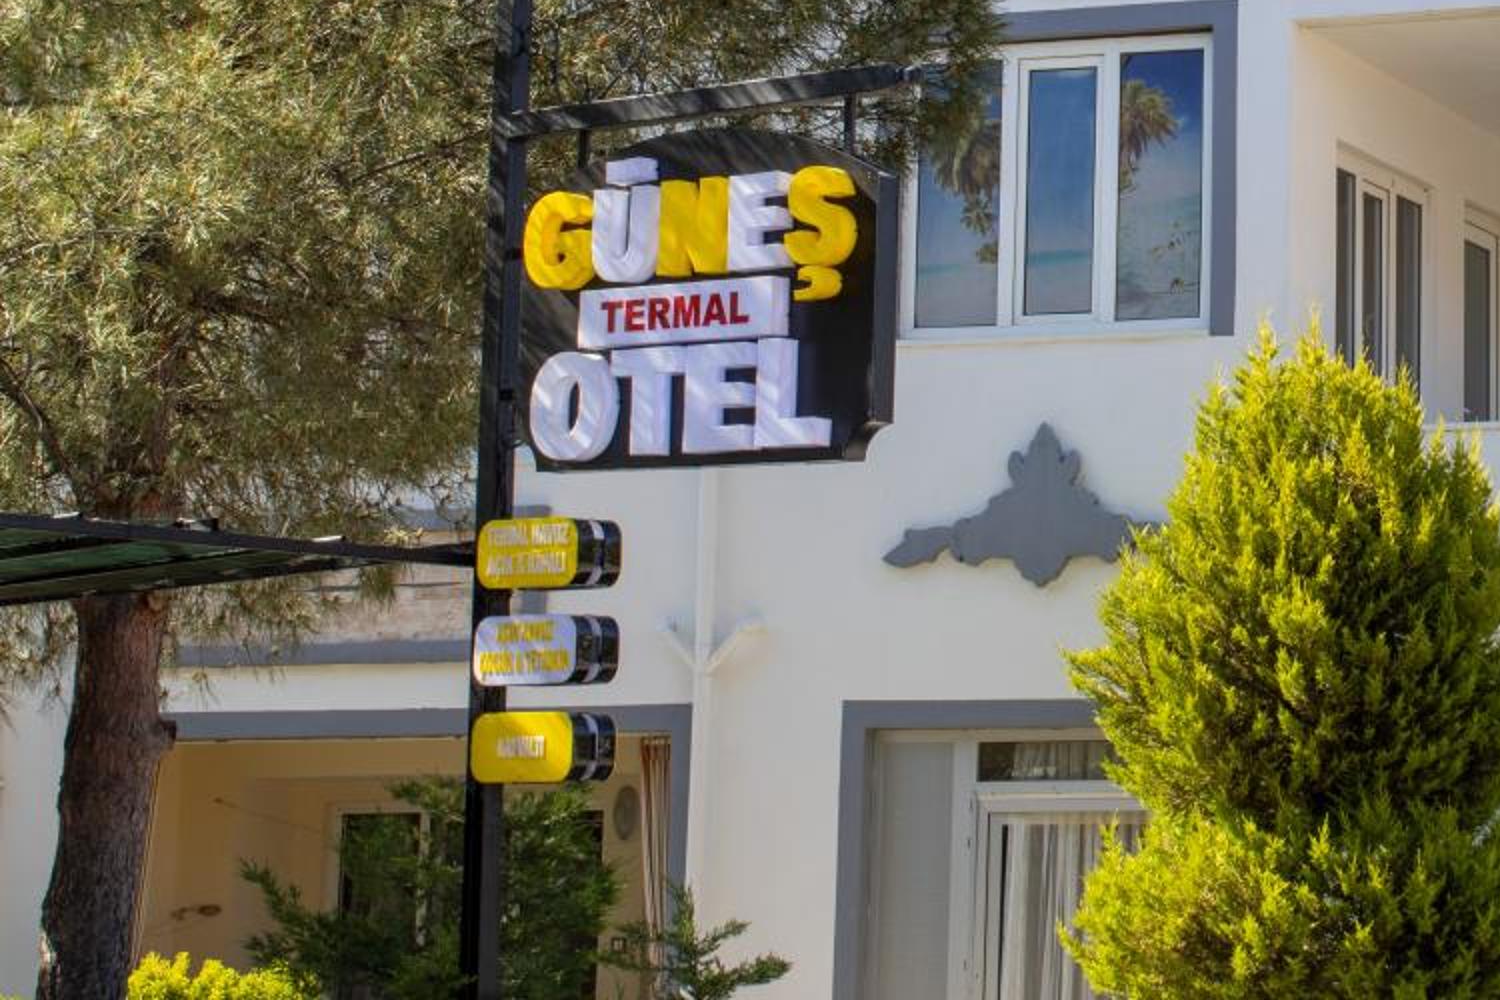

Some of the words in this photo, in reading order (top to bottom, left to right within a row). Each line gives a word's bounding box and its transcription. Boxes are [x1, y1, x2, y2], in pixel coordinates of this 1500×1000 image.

[523, 157, 858, 301] GÜNEŞ
[601, 291, 750, 334] TERMAL
[529, 337, 832, 462] OTEL
